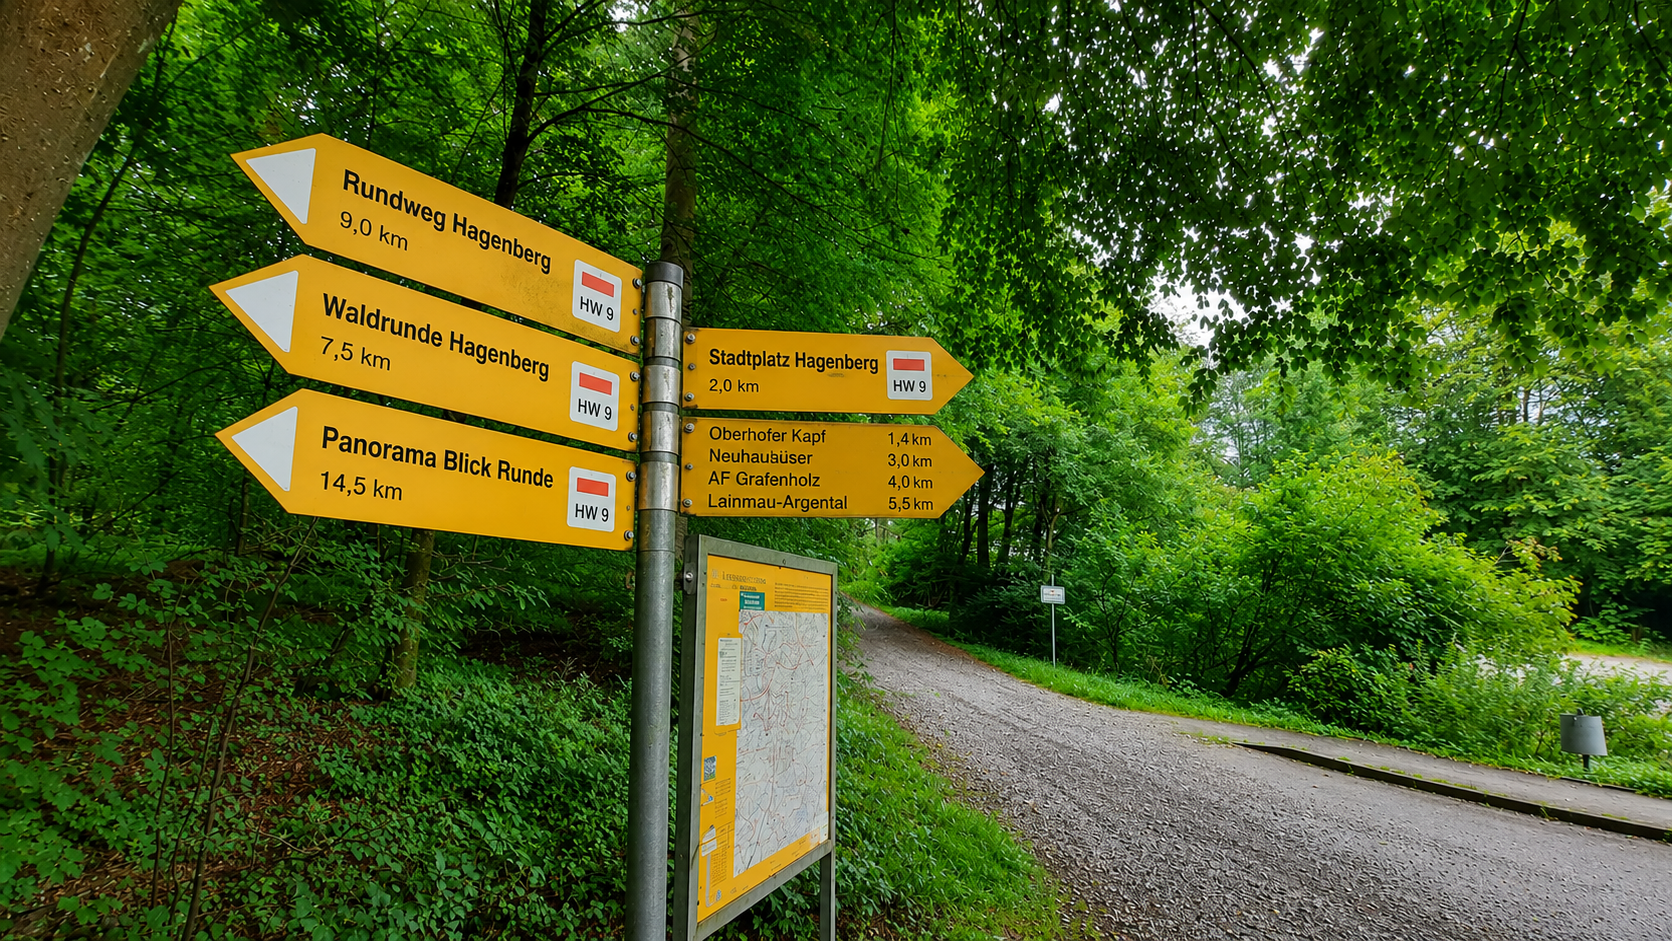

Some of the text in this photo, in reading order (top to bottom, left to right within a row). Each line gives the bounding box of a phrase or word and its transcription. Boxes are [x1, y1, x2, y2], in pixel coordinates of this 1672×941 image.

[340, 211, 408, 251] 9,0 km
[342, 168, 552, 275] Rundweg Hagenberg
[579, 296, 614, 321] HW 9
[322, 292, 550, 383] Waldrunde Hagenberg
[320, 336, 391, 371] 7,5 km
[709, 349, 879, 375] Stadtplatz Hagenberg
[709, 379, 759, 395] 2,0 km
[893, 380, 927, 393] HW 9
[577, 399, 612, 421] HW 9
[709, 426, 932, 448] Oberhofer Kapf 1,4 km
[321, 426, 554, 489] Panorama Blick Runde
[887, 453, 910, 470] 3,0
[912, 455, 933, 468] km
[320, 471, 403, 501] 14,5 km
[707, 471, 933, 492] AF Grafenholz 4,0 km
[574, 504, 609, 523] HW 9
[708, 494, 934, 513] Lainmau-Argental 5,5 km
